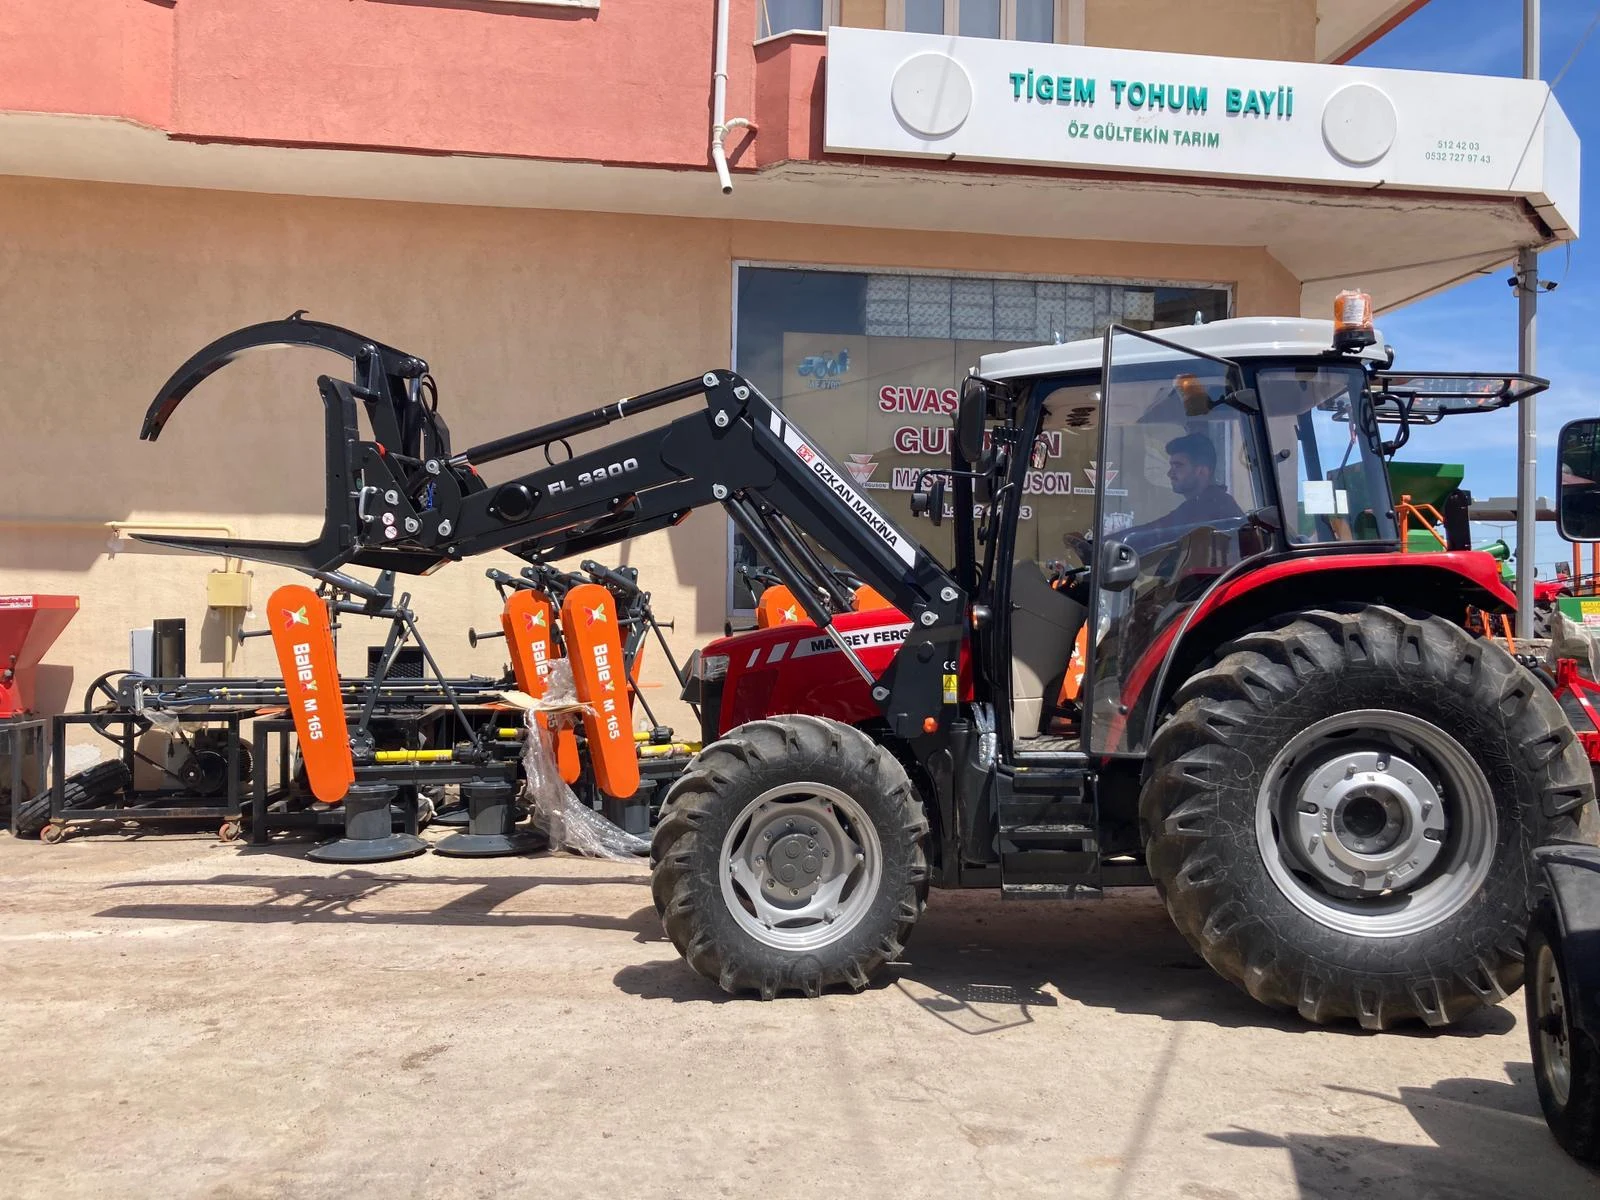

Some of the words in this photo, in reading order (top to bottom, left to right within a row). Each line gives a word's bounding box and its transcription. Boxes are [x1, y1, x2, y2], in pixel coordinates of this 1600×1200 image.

[1009, 68, 1096, 104] TİGEM
[1110, 79, 1208, 111] TOHUM
[1068, 120, 1089, 138] ÖZ
[1093, 123, 1169, 144] GÜLTEKİN
[1173, 130, 1220, 148] TARIM
[1438, 140, 1454, 149] 512
[1456, 141, 1467, 150] 42
[1469, 142, 1480, 151] 03
[1425, 152, 1447, 161] 0532
[1449, 153, 1465, 162] 727
[1467, 154, 1478, 163] 97
[1480, 155, 1491, 163] 43
[547, 480, 574, 496] FL
[577, 457, 639, 487] 3300
[813, 461, 855, 503] ÖZKAN
[852, 498, 898, 547] MAKİNA
[810, 633, 870, 652] MASEY
[943, 661, 956, 671] CE
[304, 698, 318, 712] M
[603, 699, 615, 712] M
[307, 715, 323, 740] 165
[606, 715, 620, 740] 165
